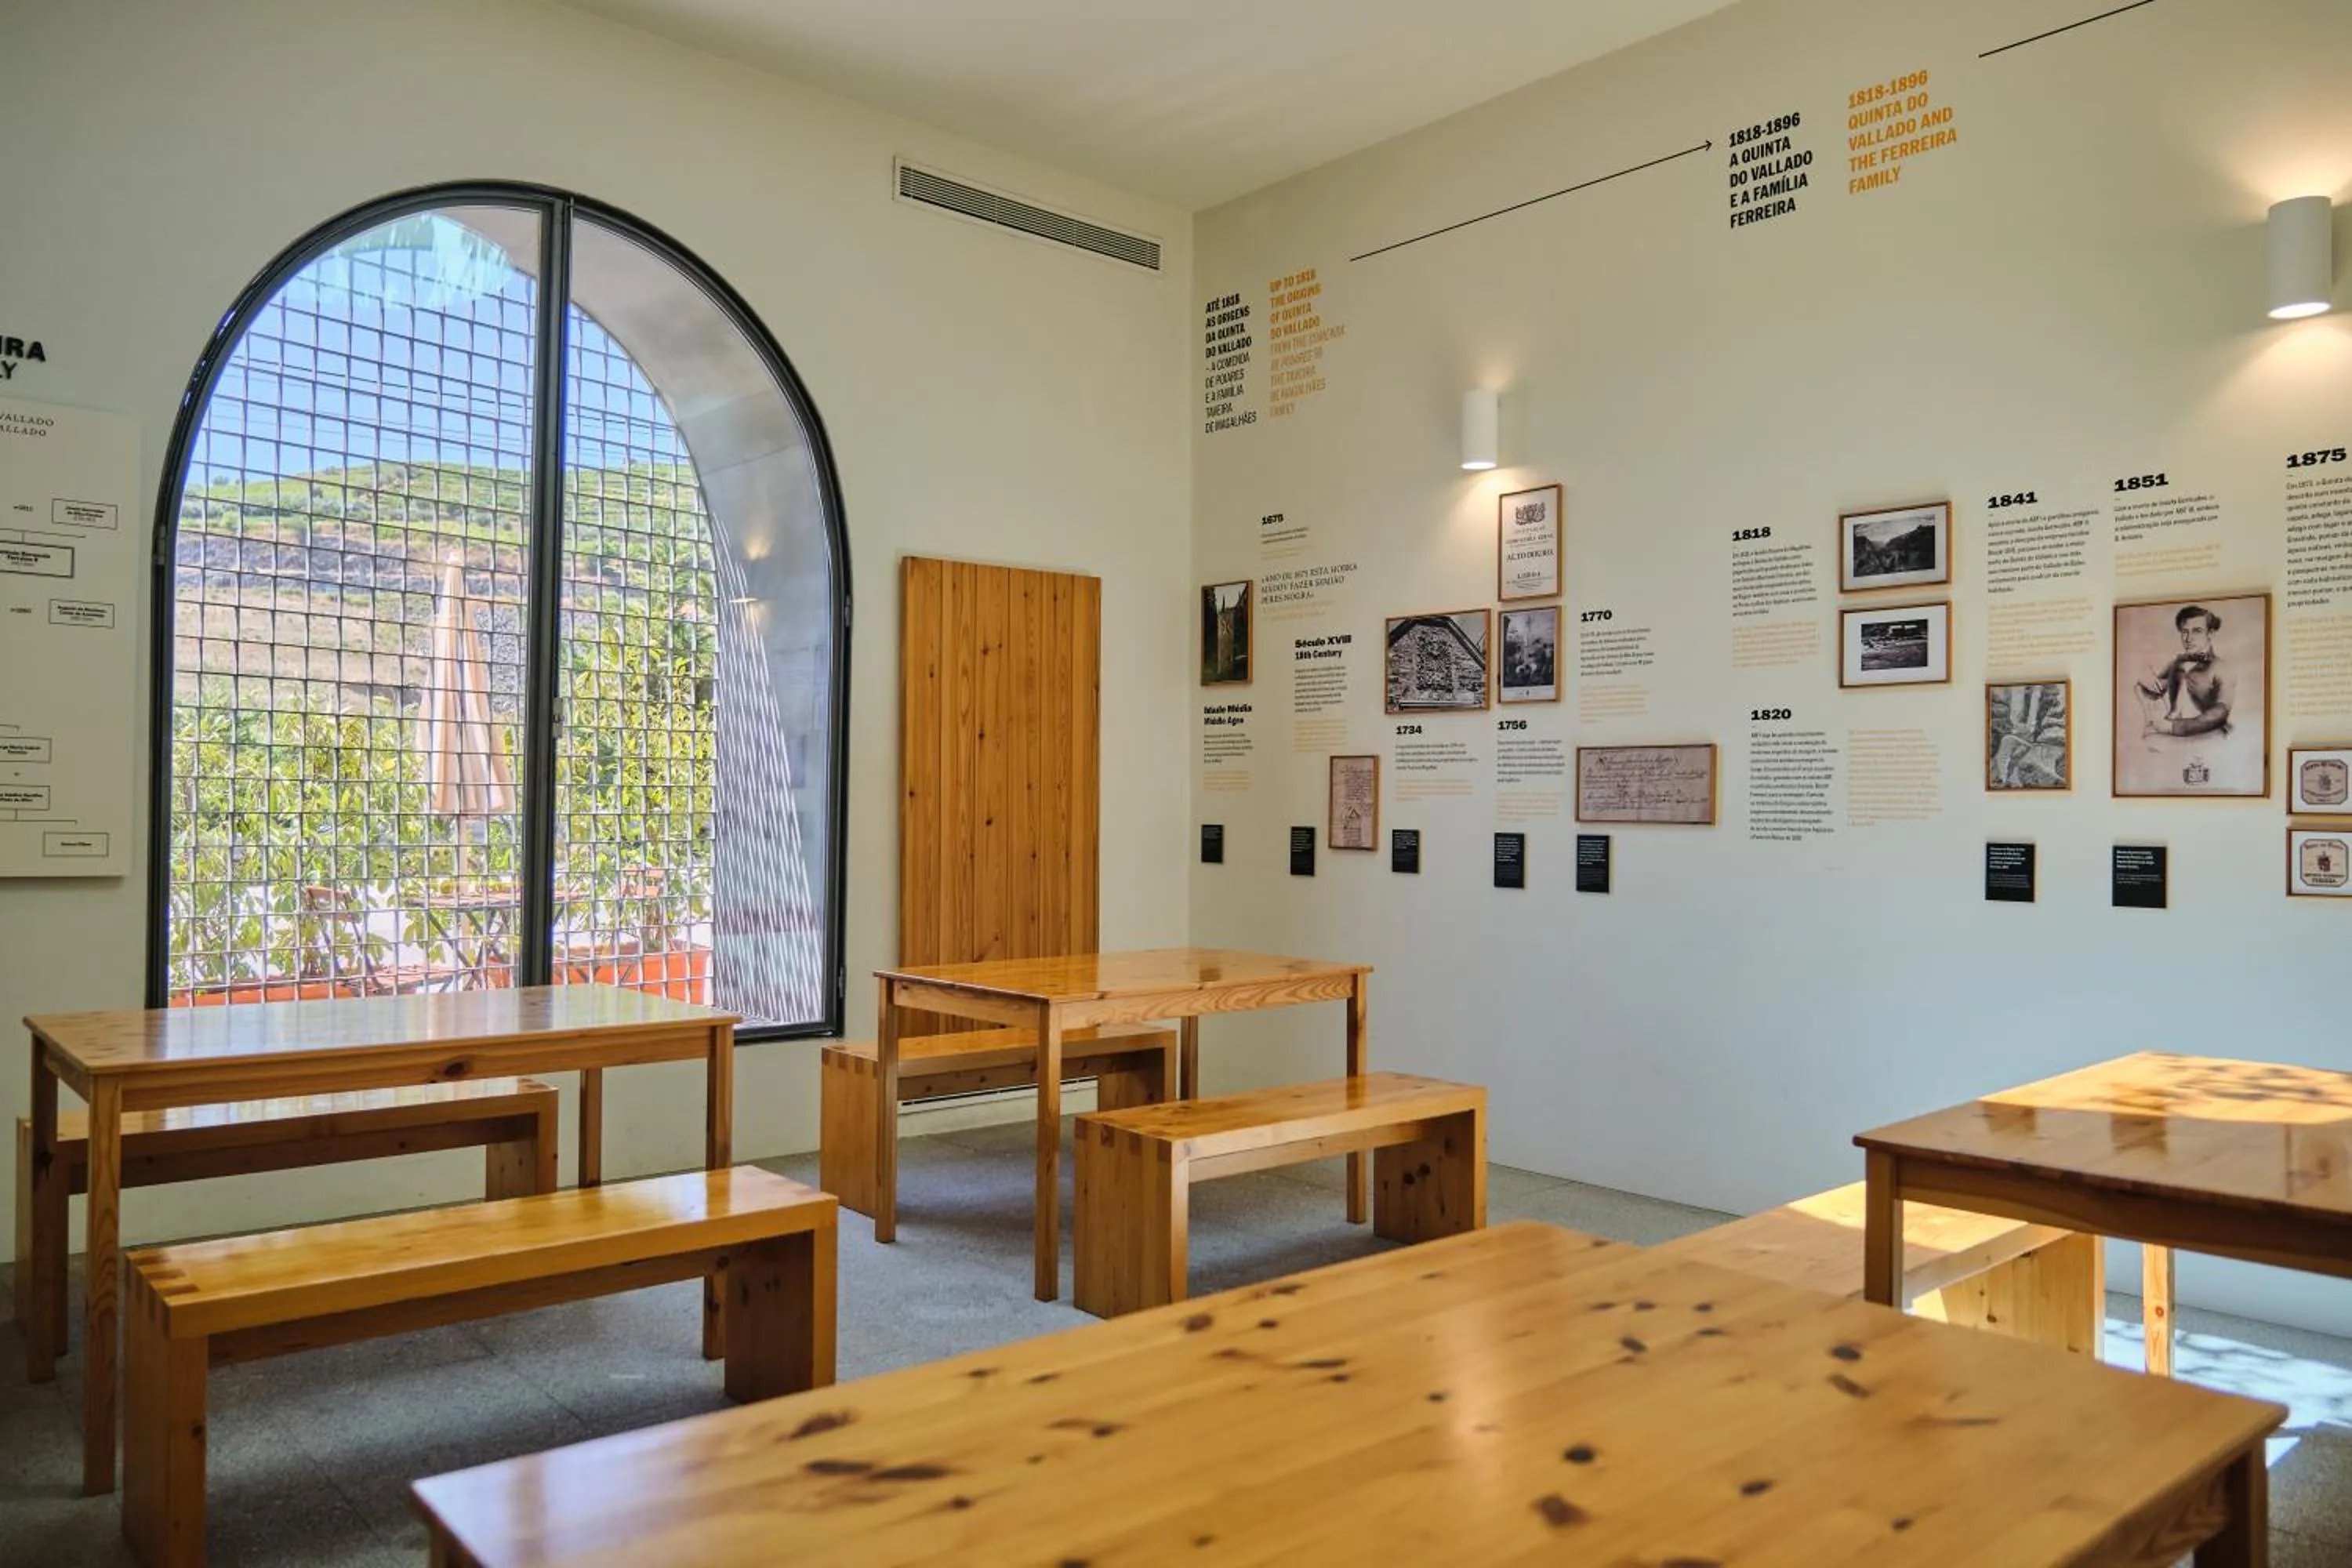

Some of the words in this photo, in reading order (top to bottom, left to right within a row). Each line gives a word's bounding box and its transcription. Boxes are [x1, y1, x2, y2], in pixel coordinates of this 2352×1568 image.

[1848, 70, 1928, 109] 1818-1896
[1848, 100, 1903, 130] QUINTA
[1907, 92, 1929, 111] DO
[1729, 112, 1801, 147] 1818-1896
[1849, 118, 1916, 151] VALLADO
[1921, 106, 1954, 129] AND
[1730, 153, 1739, 168] A
[1741, 136, 1791, 165] QUINTA
[1849, 151, 1877, 172] THE
[1882, 128, 1958, 164] FERREIRA
[1730, 169, 1748, 188] DO
[1751, 150, 1813, 181] VALLADO
[1849, 165, 1901, 195] FAMILY
[1730, 194, 1738, 208] E
[1740, 189, 1751, 205] A
[1754, 172, 1808, 201] FAMÍLIA
[1730, 197, 1796, 229] FERREIRA
[1206, 297, 1220, 314] ATÉ
[1270, 294, 1286, 308] THE
[1206, 316, 1215, 329] AS
[1217, 305, 1250, 325] ORIGENS
[1206, 332, 1216, 345] DA
[1218, 322, 1246, 341] QUINTA
[1206, 346, 1216, 358] DO
[1218, 336, 1252, 355] VALLADO
[2285, 448, 2347, 468] 1875
[2114, 473, 2169, 492] 1851
[1987, 491, 2038, 509] 1841
[1732, 526, 1772, 541] 1818
[1581, 609, 1613, 622] 1770
[1497, 720, 1527, 731] 1756
[1751, 708, 1791, 720] 1820
[1396, 724, 1422, 735] 1734
